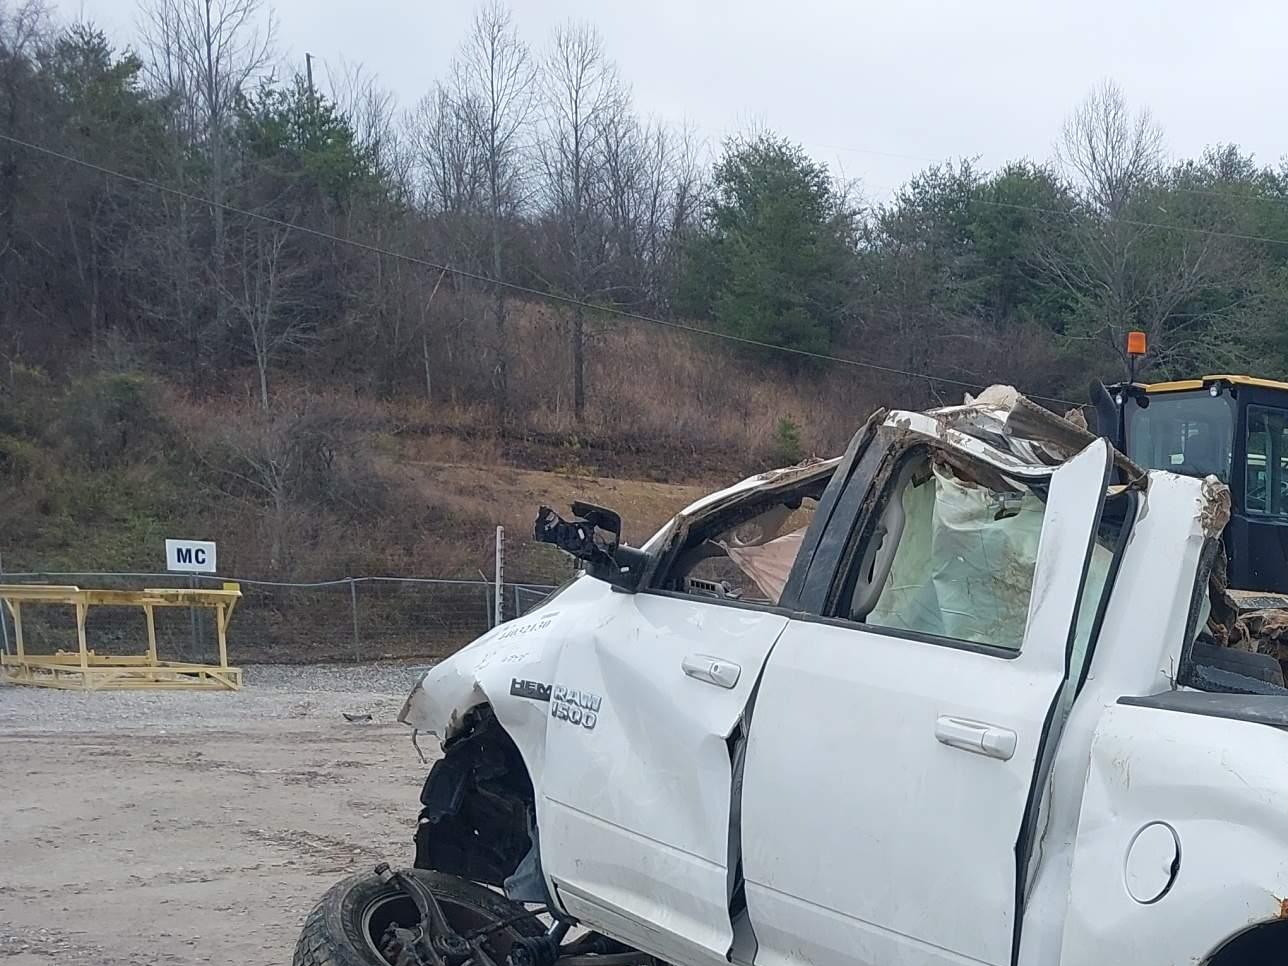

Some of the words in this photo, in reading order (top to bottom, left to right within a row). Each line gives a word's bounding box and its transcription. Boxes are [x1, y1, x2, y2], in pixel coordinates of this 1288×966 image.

[176, 547, 206, 565] MC
[554, 686, 603, 713] RAM
[551, 701, 598, 730] 1500
